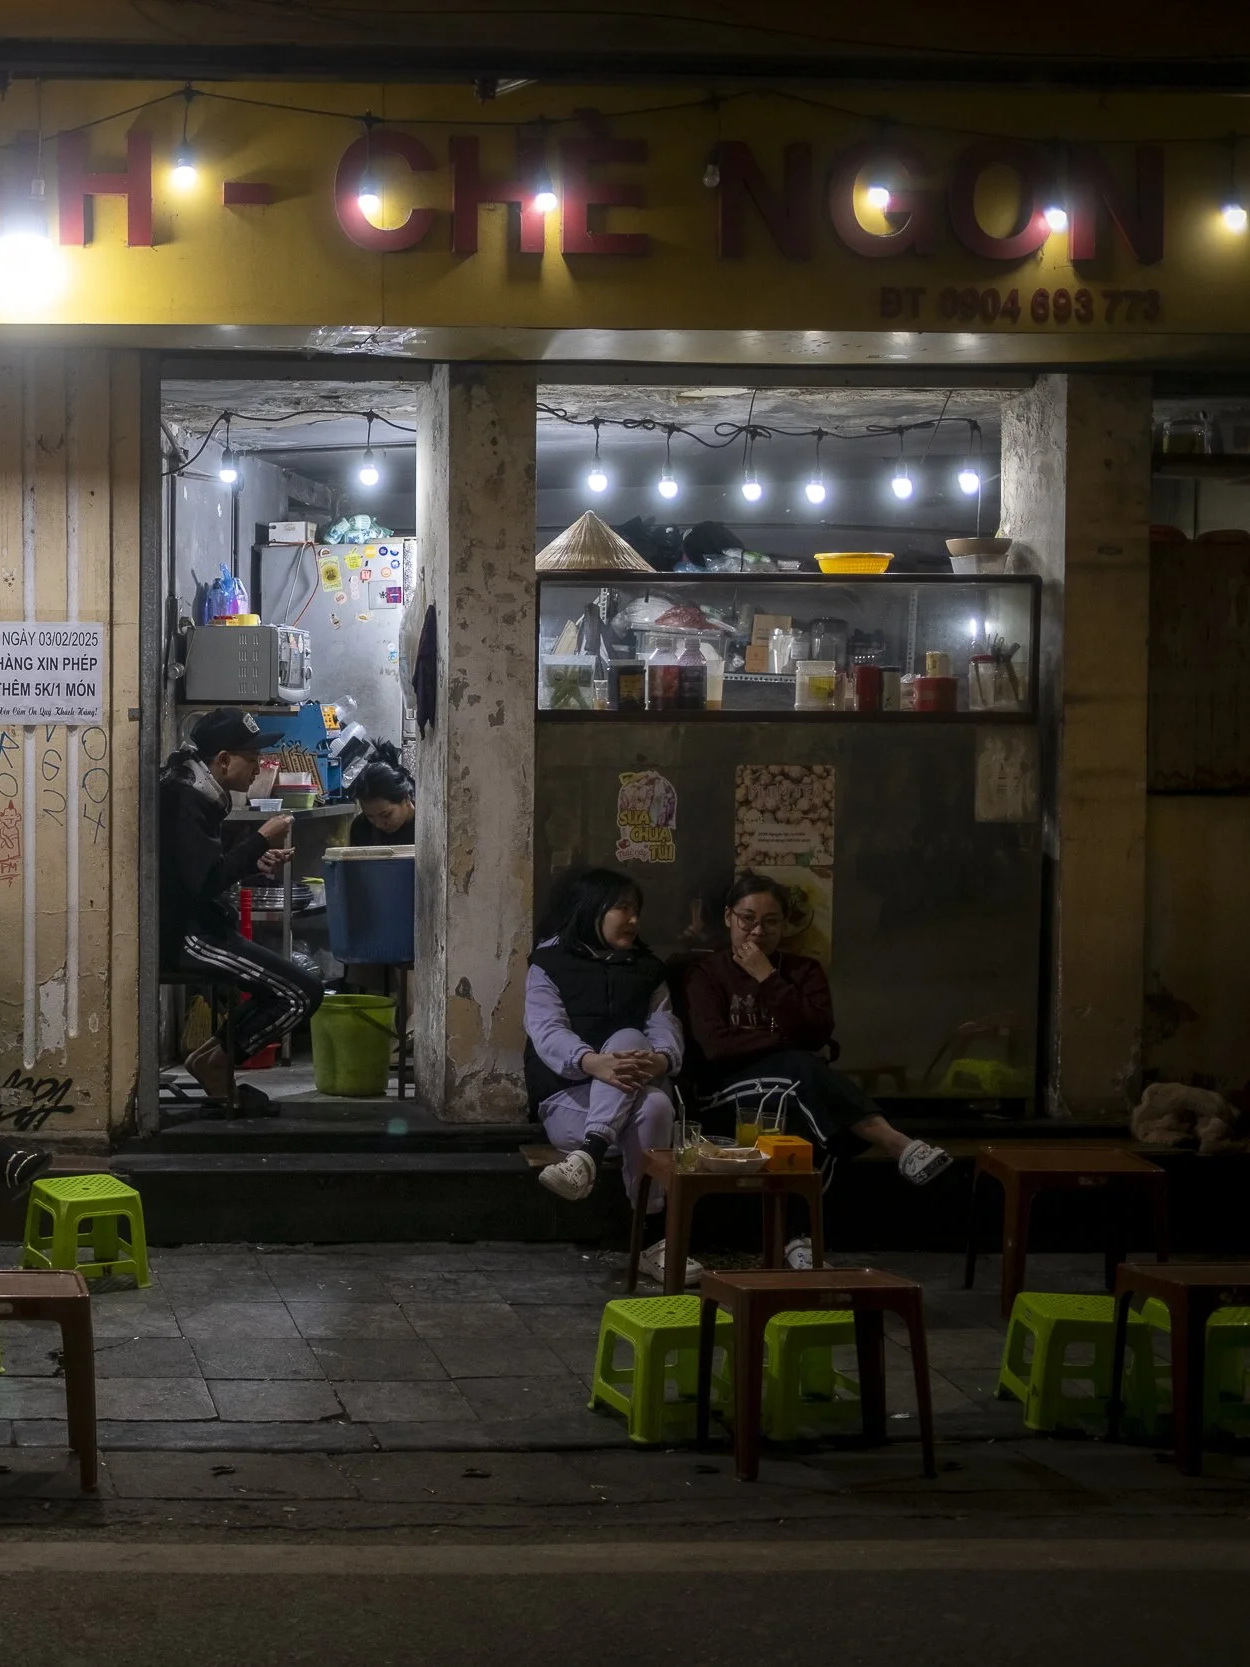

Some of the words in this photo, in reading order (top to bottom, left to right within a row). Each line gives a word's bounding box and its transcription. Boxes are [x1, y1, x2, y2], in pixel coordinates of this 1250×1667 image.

[334, 108, 649, 253] CHÈ
[720, 141, 1164, 262] NGON
[2, 628, 36, 646] NGÀY
[38, 631, 99, 647] 03/02/2025
[37, 657, 58, 671] XIN
[62, 654, 98, 671] PHÉP
[34, 683, 61, 697] 5K/1
[65, 680, 96, 697] MÓN
